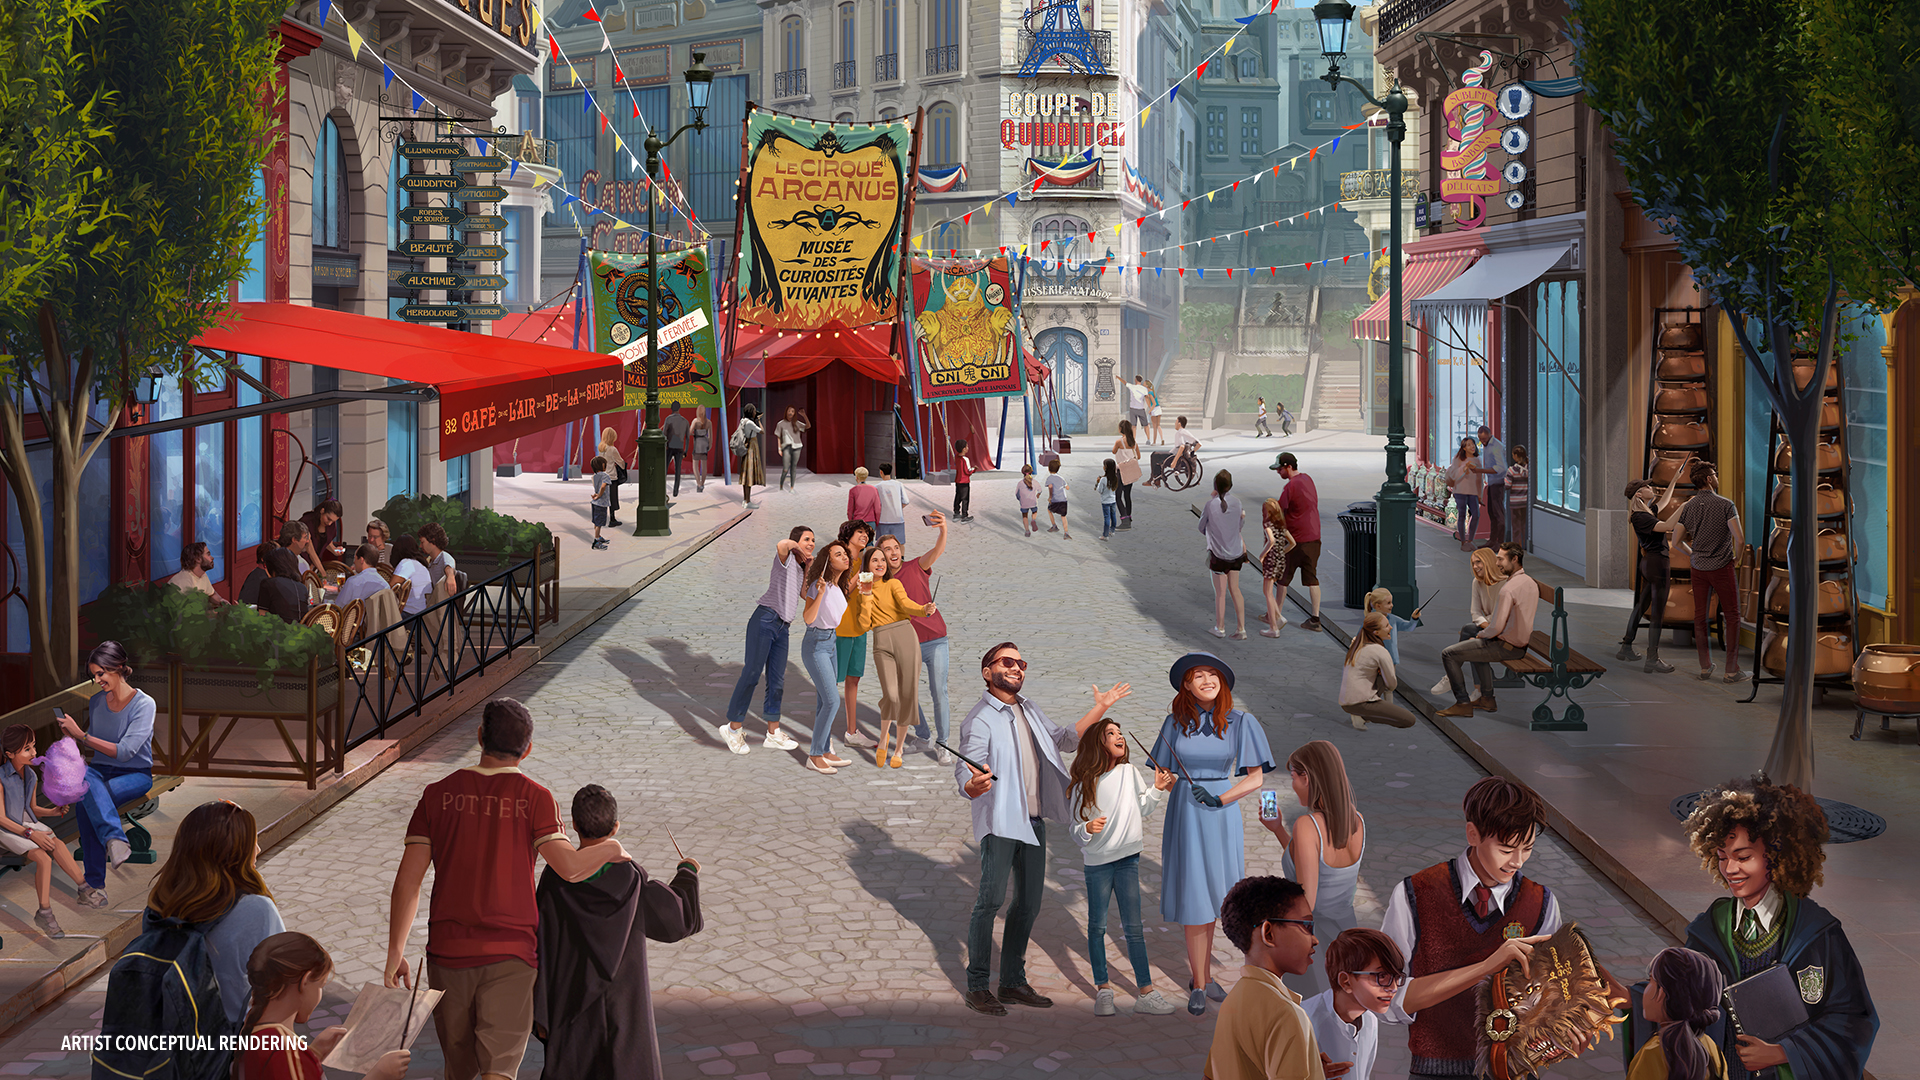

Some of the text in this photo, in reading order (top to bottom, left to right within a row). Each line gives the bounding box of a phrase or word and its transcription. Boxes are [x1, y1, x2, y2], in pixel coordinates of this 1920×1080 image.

[1009, 92, 1117, 116] COUPE DE
[1449, 90, 1497, 105] SUBLIMES
[1000, 119, 1125, 151] QUIDDITCH
[405, 147, 460, 155] ILLUMINATIONS
[1452, 134, 1492, 168] BONBONS
[775, 158, 884, 179] LE CIRQUE
[407, 179, 457, 188] QUIDDITCH
[756, 177, 896, 201] ARCANUS
[821, 211, 836, 226] A
[410, 242, 454, 253] BEAUTÉ
[797, 238, 854, 257] MUSÉE
[812, 256, 837, 267] DES
[407, 276, 456, 286] ALCHIMIE
[779, 265, 865, 283] CURIOSITÉS
[786, 283, 859, 304] VIVANTES
[406, 309, 458, 317] HERBOLOGIE
[663, 316, 698, 341] FERMÉE
[627, 372, 685, 387] MALICTUS
[936, 371, 960, 384] ONI
[964, 366, 977, 381] 鬼
[980, 366, 1005, 379] ONI
[445, 418, 457, 435] 32
[462, 402, 497, 433] CAFÉ
[508, 397, 536, 422] L'AIR
[545, 393, 559, 413] DE
[567, 388, 580, 407] LA
[443, 792, 528, 819] POTTER
